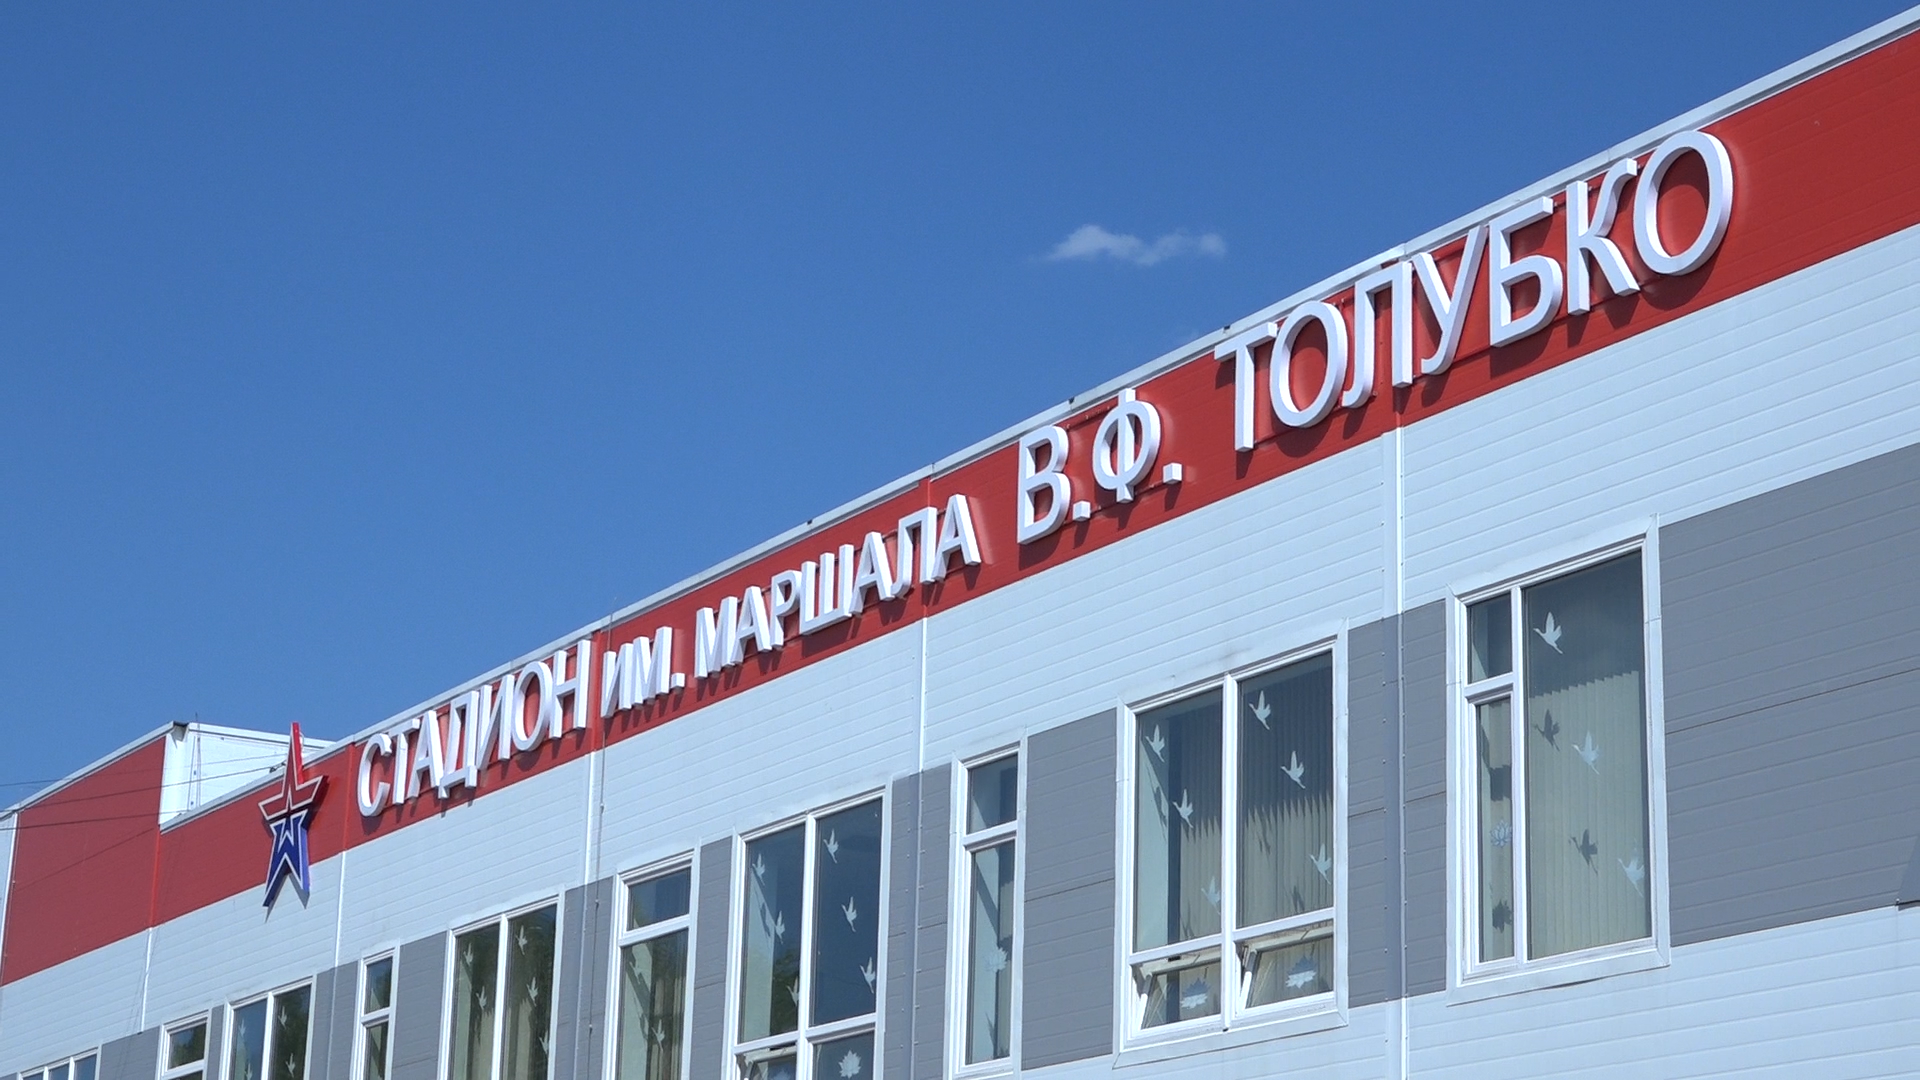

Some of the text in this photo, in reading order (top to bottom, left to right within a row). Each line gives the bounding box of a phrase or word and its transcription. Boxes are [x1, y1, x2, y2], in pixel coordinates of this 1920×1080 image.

[357, 638, 591, 817] СТАДИОН
[694, 493, 982, 679] МАРШАЛА
[1017, 388, 1183, 545] В.Ф.
[1214, 130, 1734, 453] ТОЛУБКО
